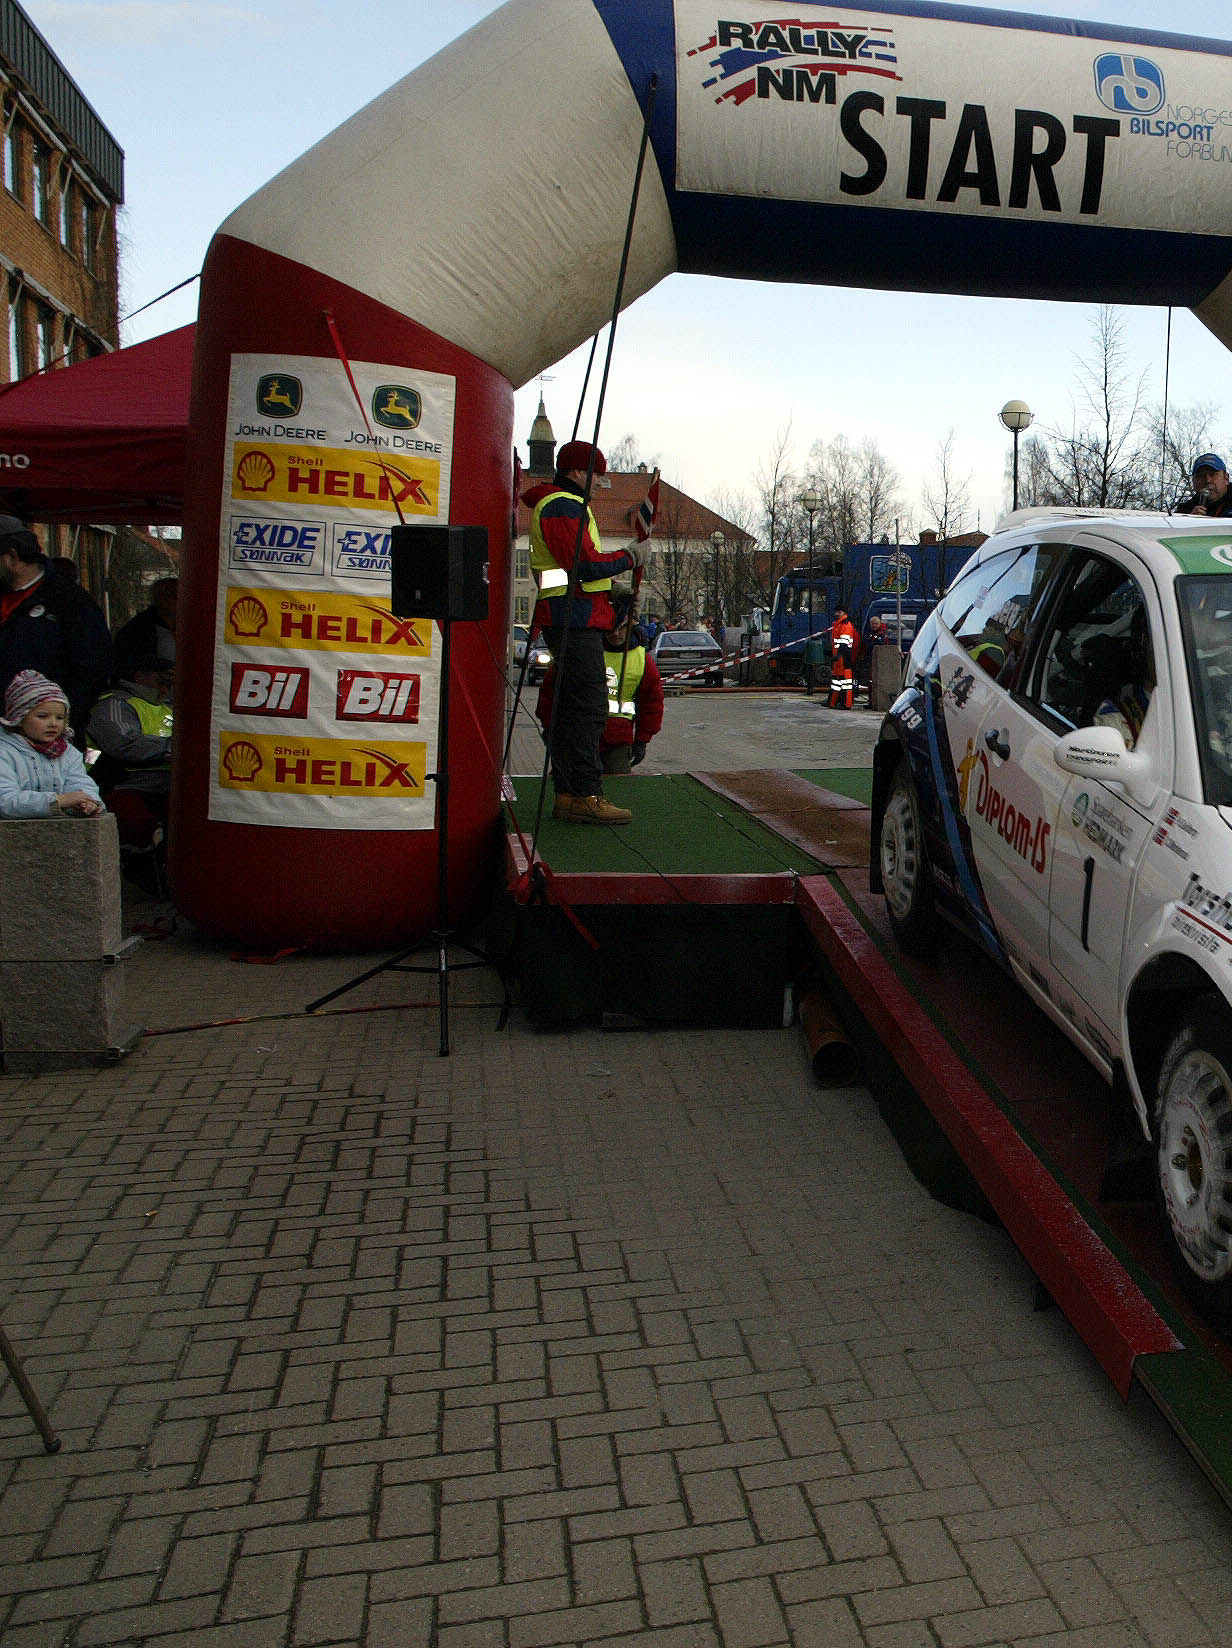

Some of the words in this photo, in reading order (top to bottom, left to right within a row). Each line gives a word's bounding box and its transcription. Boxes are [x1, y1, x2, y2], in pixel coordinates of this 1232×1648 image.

[716, 20, 869, 60] RALLY
[755, 66, 836, 104] NM
[1129, 117, 1214, 143] BILSPORT
[838, 91, 1121, 215] START
[235, 424, 271, 437] JOHN
[274, 425, 327, 441] DEERE
[344, 431, 389, 447] JOHN
[393, 435, 443, 454] DEERE
[287, 455, 324, 467] Shell
[286, 467, 430, 506] HELIX
[233, 522, 321, 551] EXIDE
[337, 530, 392, 556] EXI
[280, 601, 316, 612] Shell
[280, 612, 421, 646] HELIX
[234, 669, 302, 711] Bil
[342, 676, 415, 716] Bil
[273, 746, 311, 758] Shell
[273, 757, 419, 788] HELIX
[1081, 855, 1096, 952] 1
